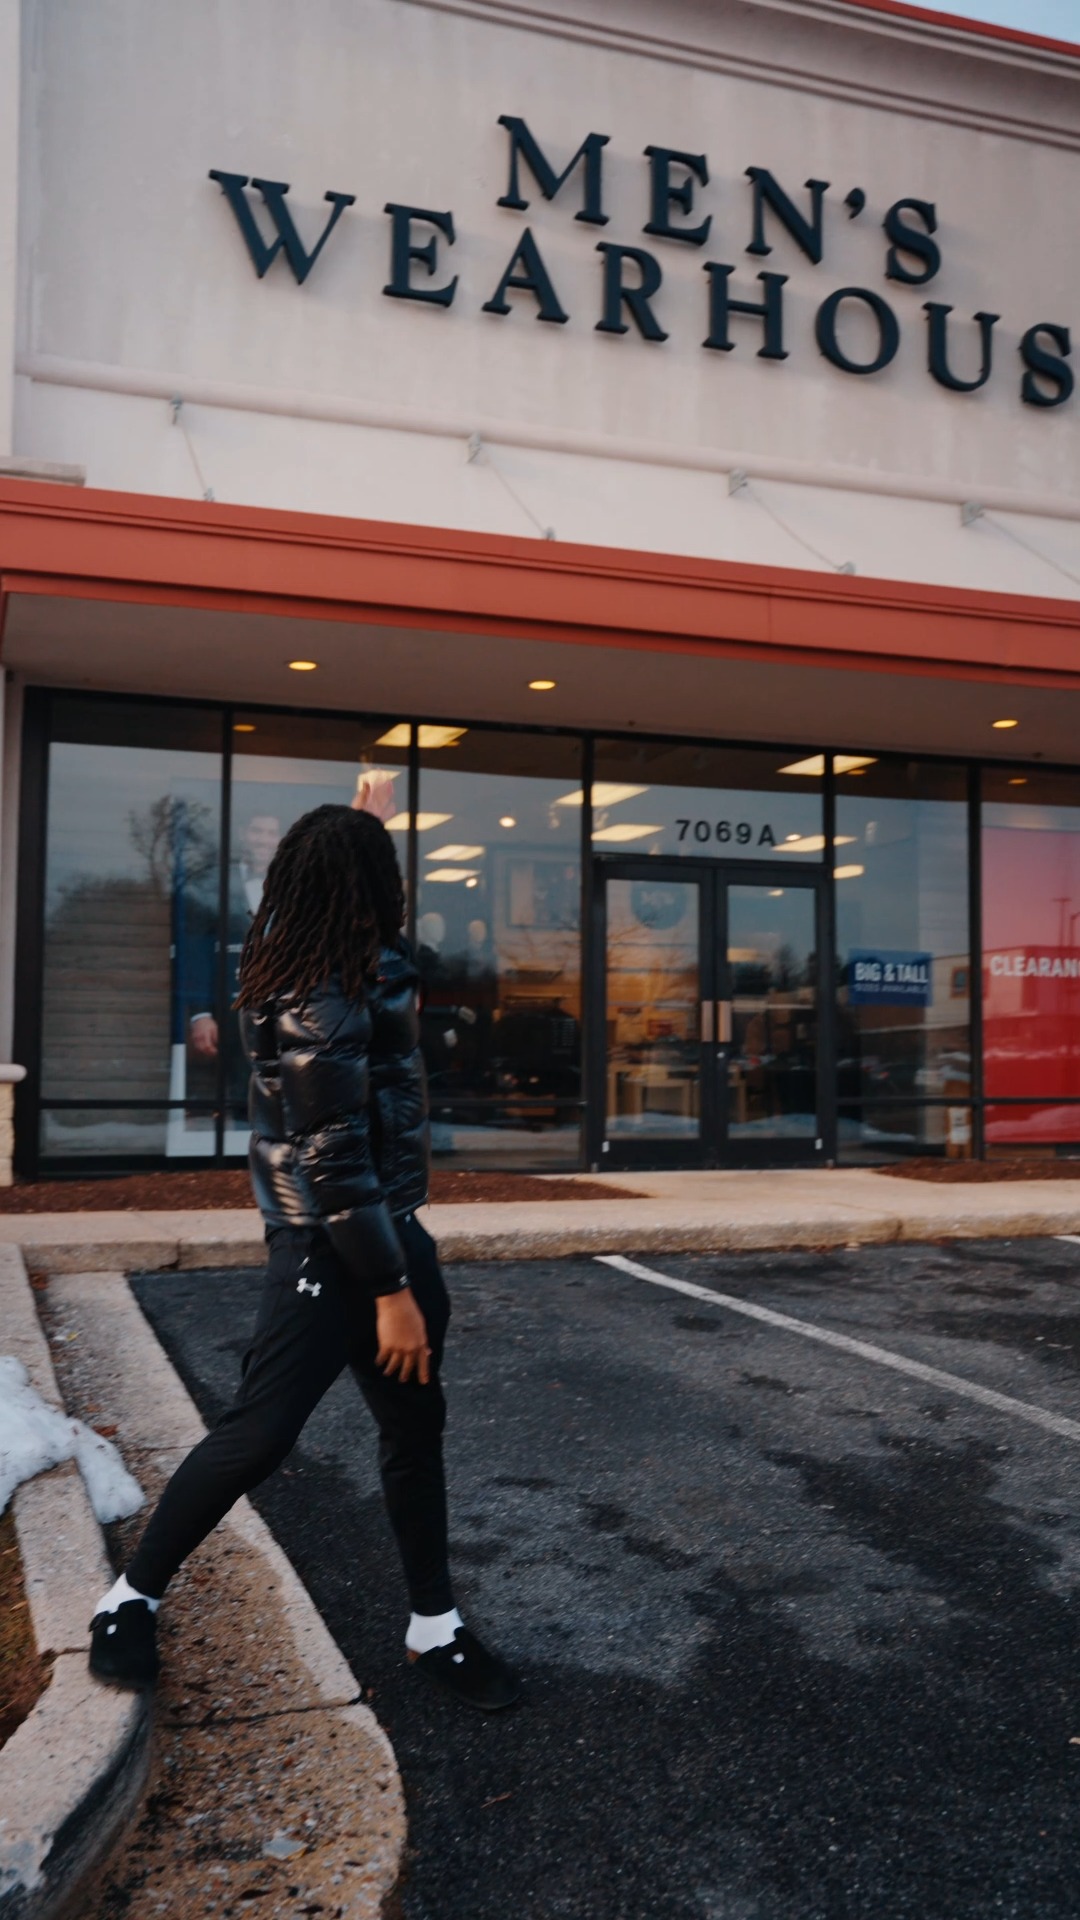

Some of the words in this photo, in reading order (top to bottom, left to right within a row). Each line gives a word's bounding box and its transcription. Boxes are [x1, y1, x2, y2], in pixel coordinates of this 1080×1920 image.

[497, 115, 942, 286] MEN'S
[209, 169, 1075, 408] WEARHOUS
[675, 819, 777, 847] 7069A
[855, 962, 881, 981] BIG
[883, 963, 895, 982] &
[896, 964, 928, 983] TALL
[990, 955, 1080, 977] CLEARAN
